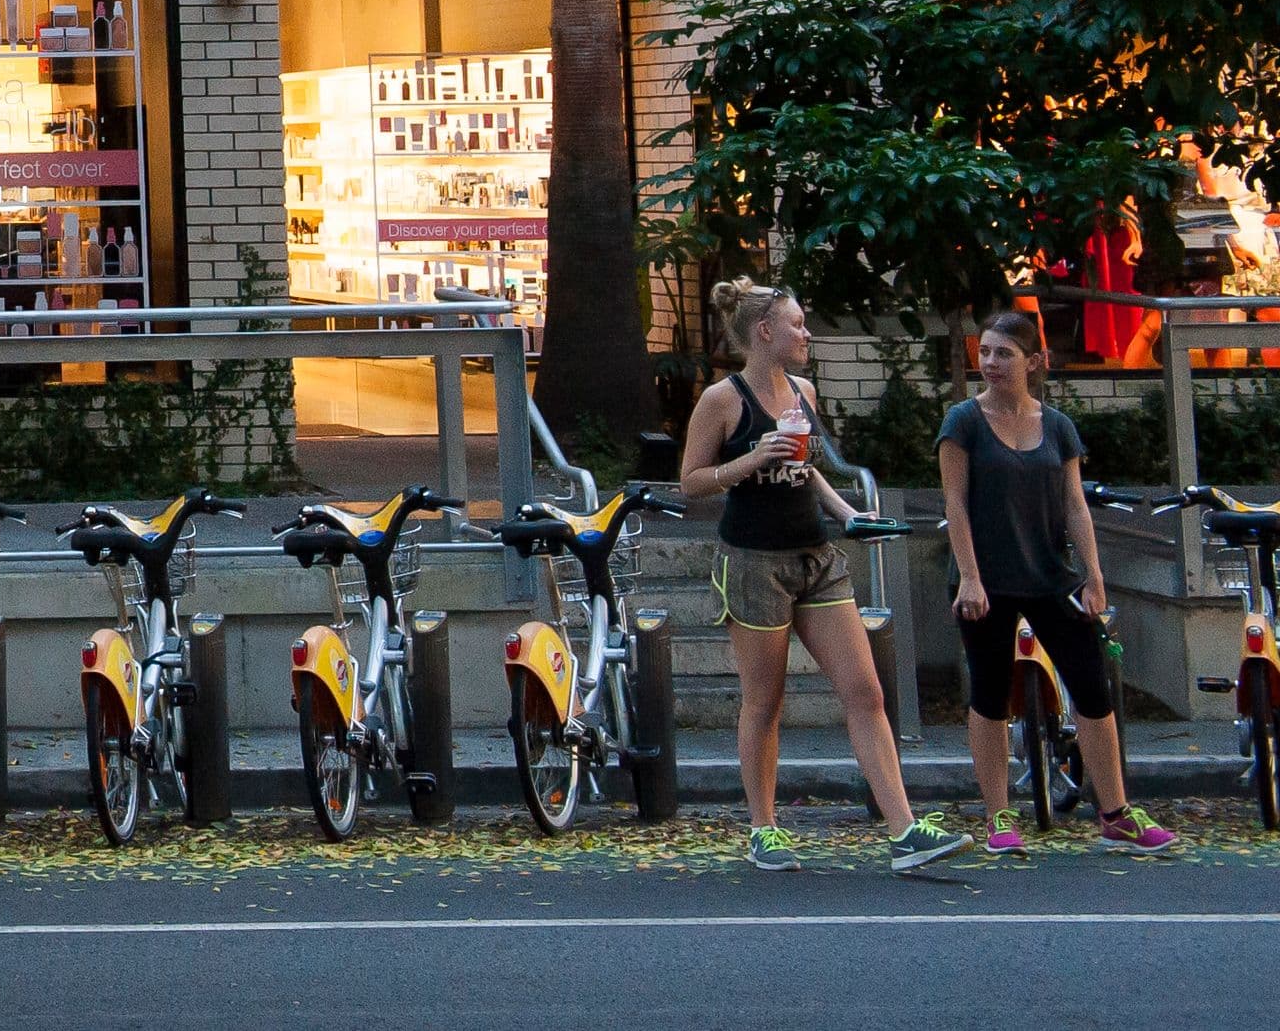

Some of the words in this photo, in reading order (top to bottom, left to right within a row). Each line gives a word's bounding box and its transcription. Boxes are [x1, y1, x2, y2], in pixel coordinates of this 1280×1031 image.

[48, 163, 110, 180] cover.
[388, 223, 448, 237] Discover
[453, 225, 482, 241] your
[488, 222, 538, 240] perfect
